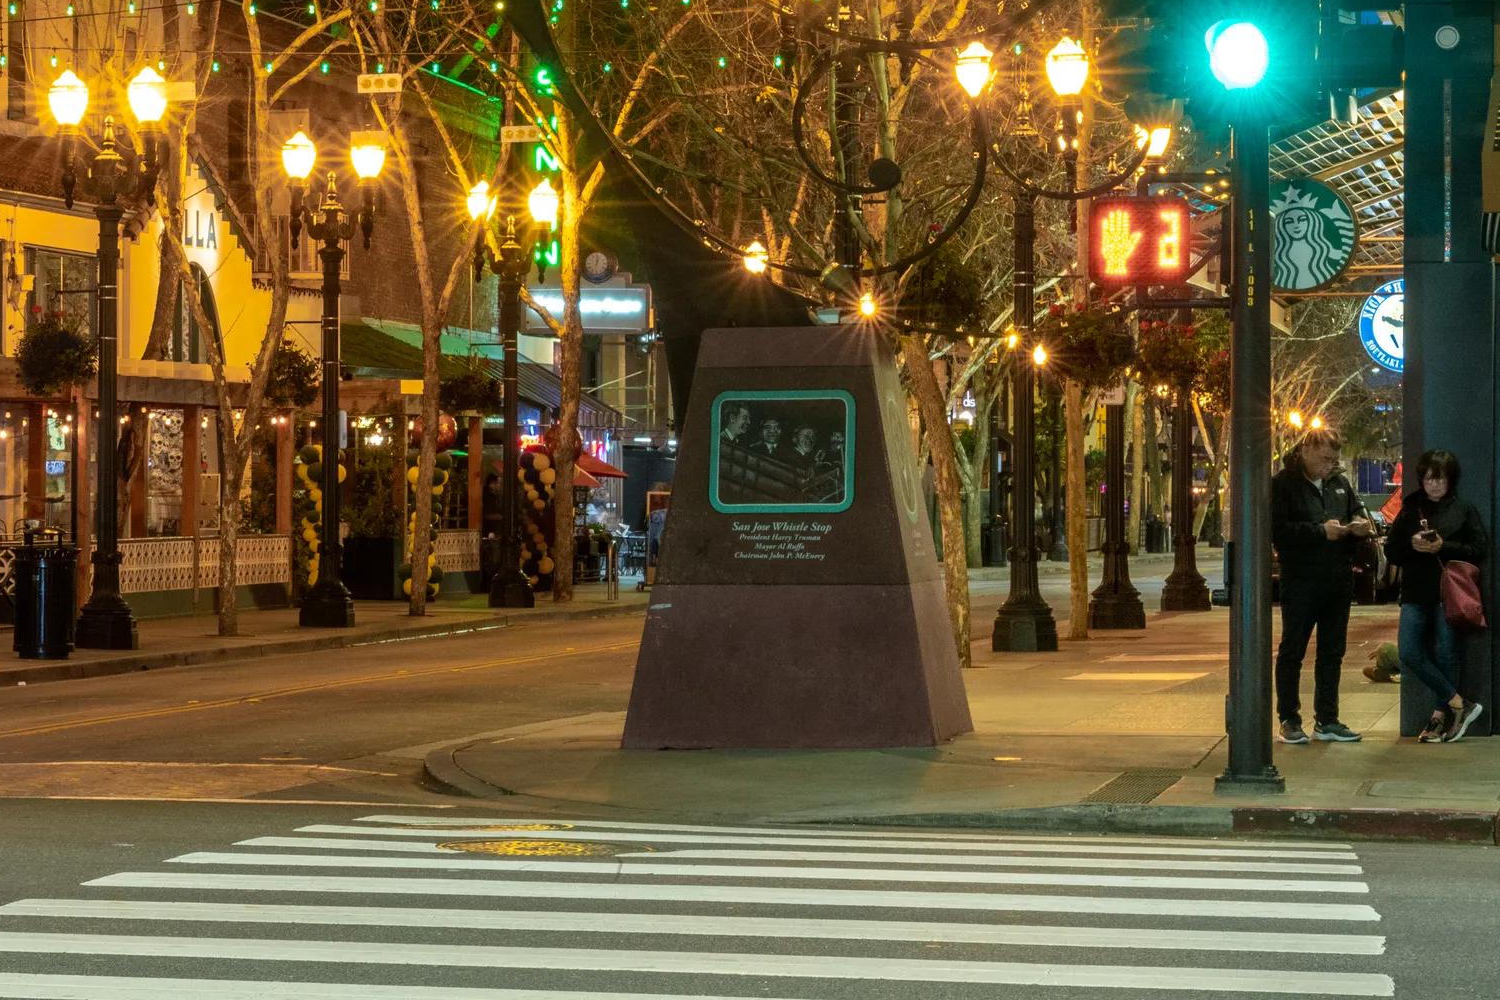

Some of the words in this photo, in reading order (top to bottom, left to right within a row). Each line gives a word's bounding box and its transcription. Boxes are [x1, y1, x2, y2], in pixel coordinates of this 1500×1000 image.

[184, 208, 218, 249] LLA
[1384, 281, 1404, 294] TH
[732, 521, 751, 532] San
[751, 521, 770, 533] Jose
[772, 521, 809, 532] Whistle
[810, 521, 832, 534] Stop
[771, 533, 792, 543] Harry
